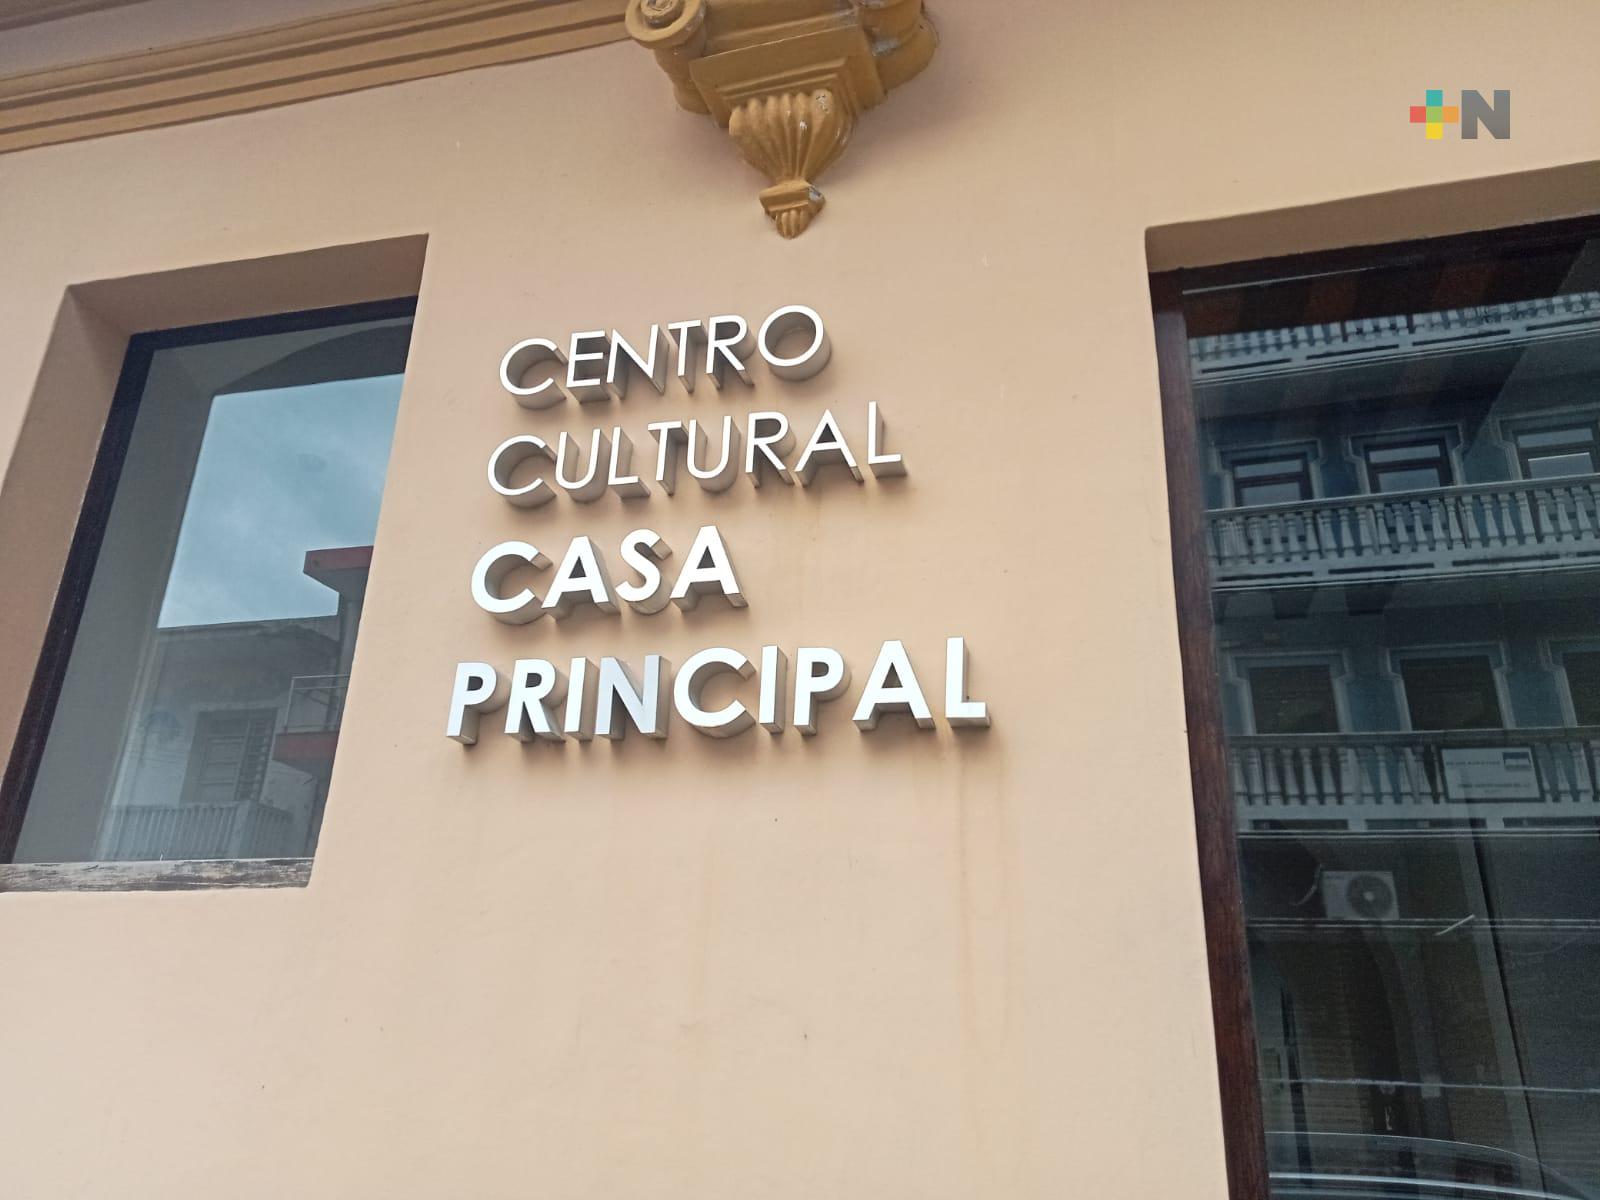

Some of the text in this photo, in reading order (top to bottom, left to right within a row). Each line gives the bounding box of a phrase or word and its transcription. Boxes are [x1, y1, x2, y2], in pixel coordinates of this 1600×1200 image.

[499, 304, 827, 397] CENTRO
[487, 401, 903, 498] CULTURAL
[470, 525, 742, 613] CASA
[446, 637, 988, 739] PRINCIPAL
